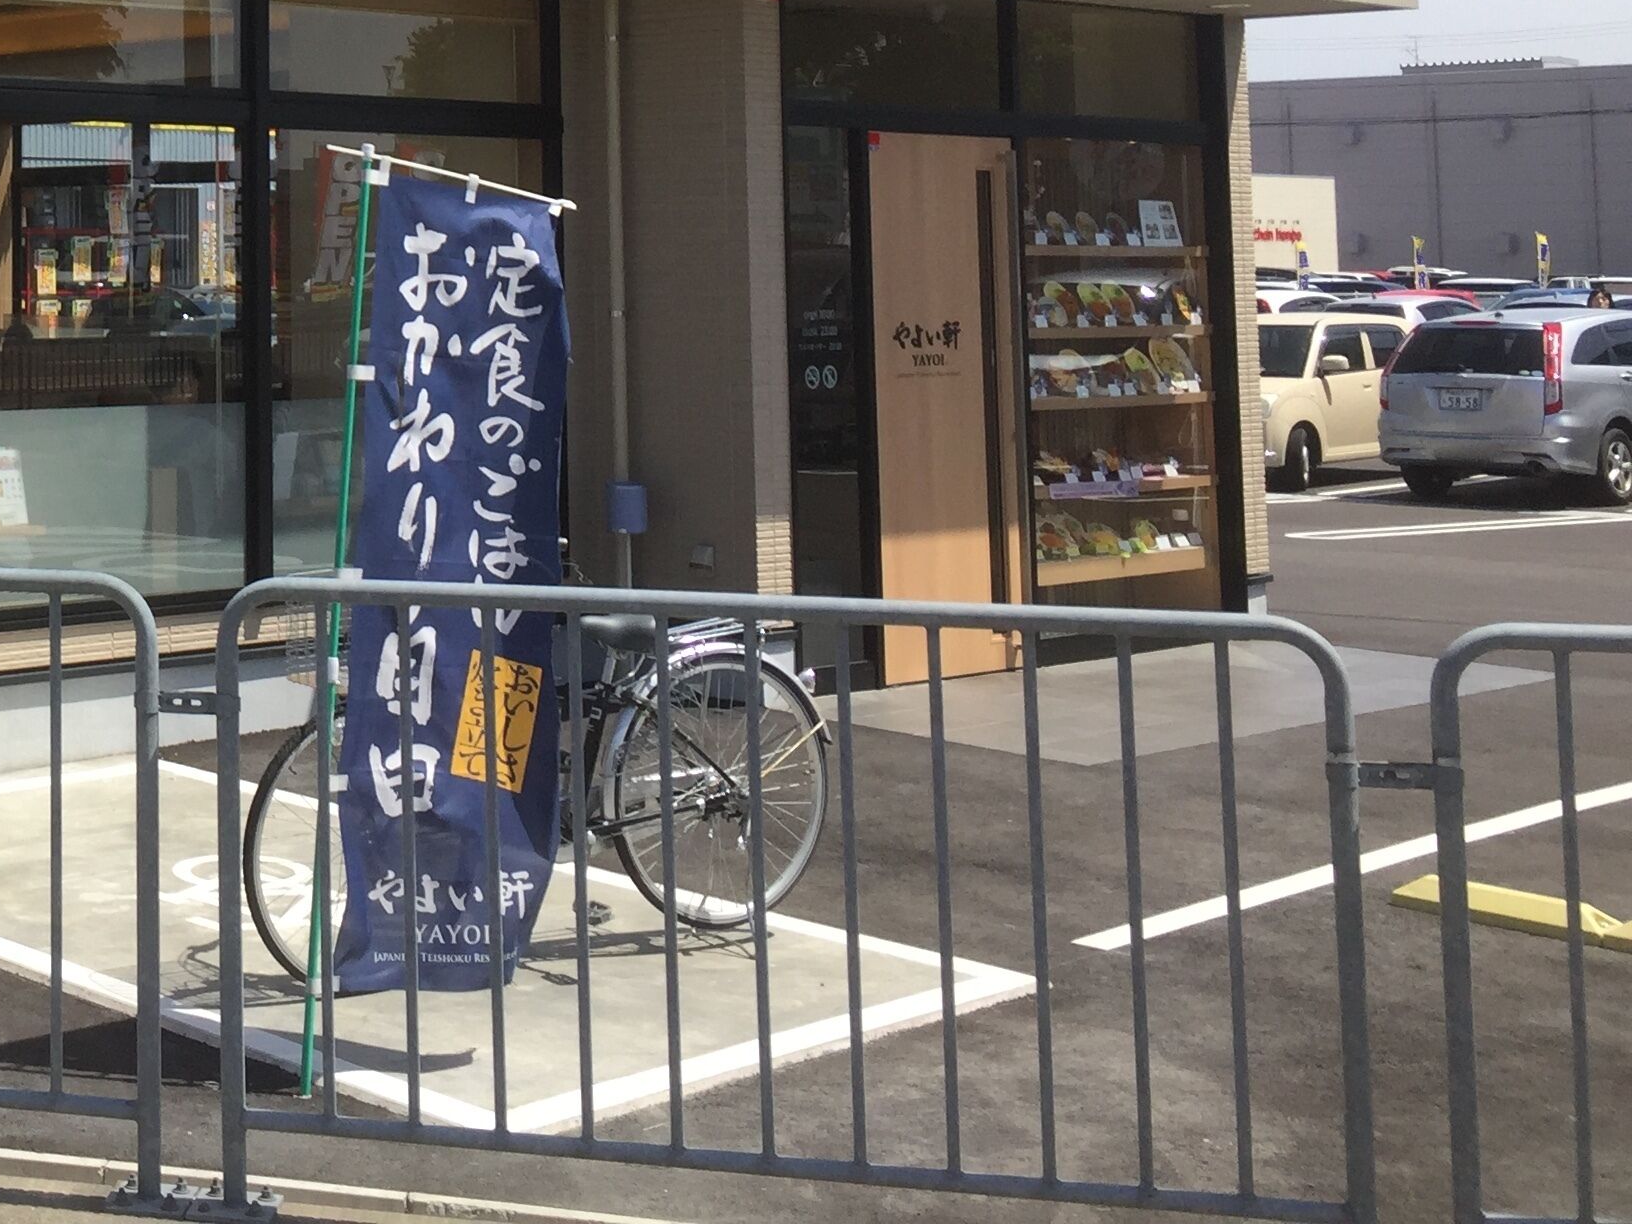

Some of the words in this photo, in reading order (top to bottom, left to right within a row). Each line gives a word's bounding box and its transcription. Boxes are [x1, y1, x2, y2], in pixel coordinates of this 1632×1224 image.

[893, 321, 961, 350] やよい軒
[912, 354, 945, 366] YAYOI
[368, 870, 534, 919] やよい軒
[415, 924, 490, 944] YAYOI
[420, 952, 471, 963] TEISHOKU
